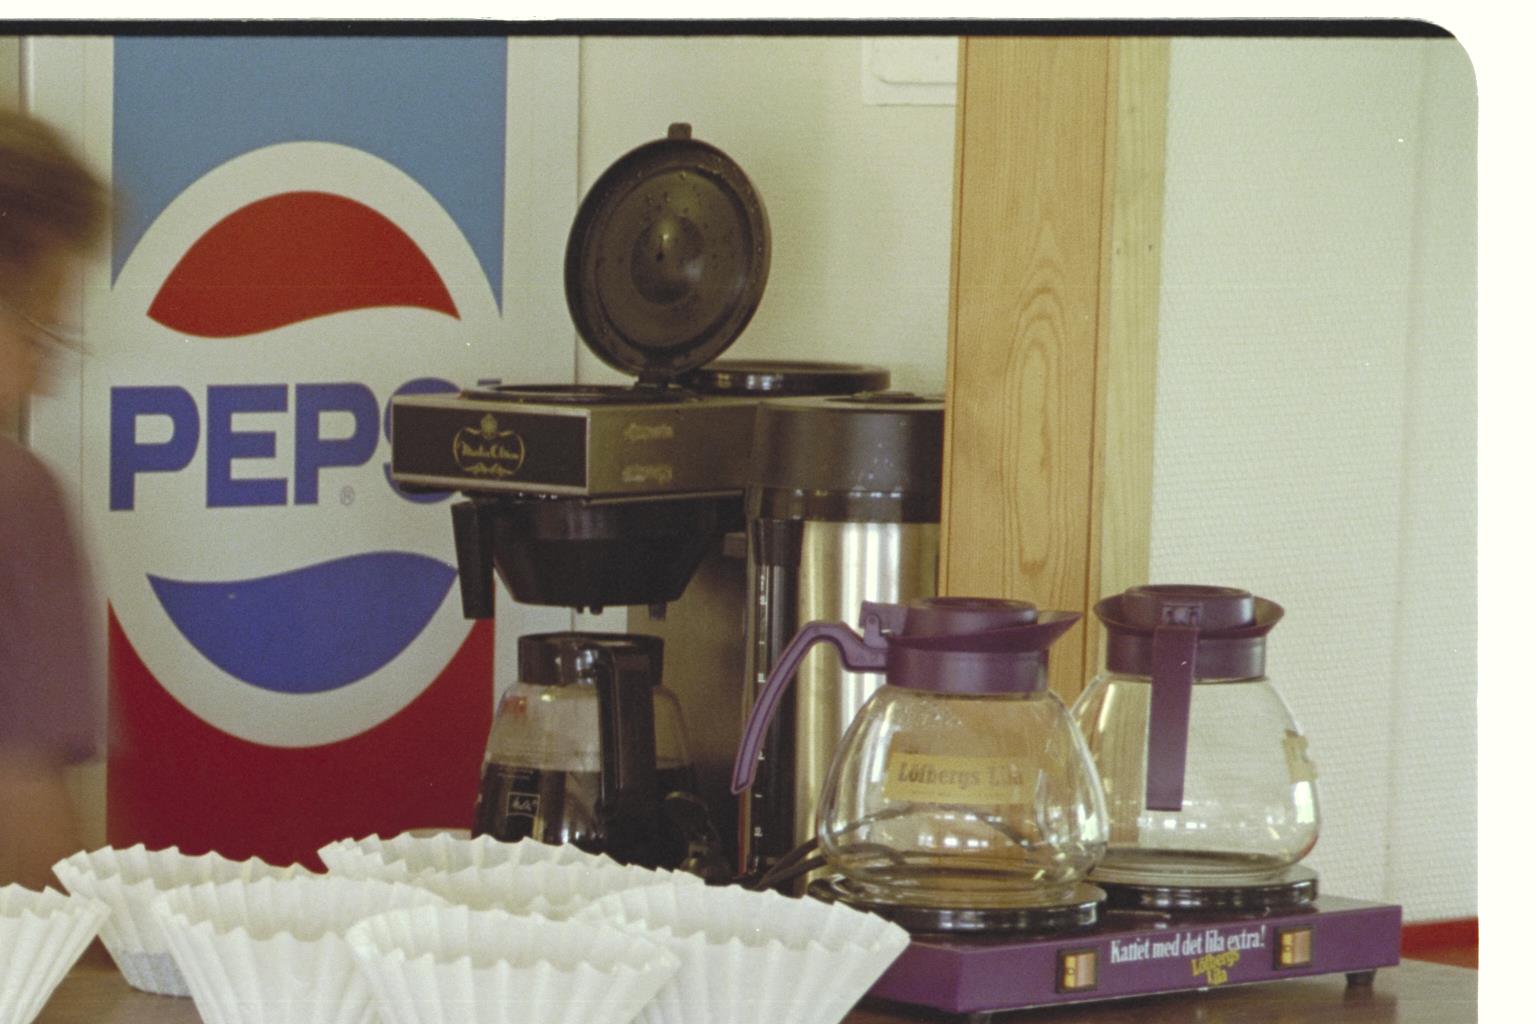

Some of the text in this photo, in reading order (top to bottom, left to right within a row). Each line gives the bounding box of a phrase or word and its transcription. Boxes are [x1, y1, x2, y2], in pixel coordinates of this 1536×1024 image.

[109, 377, 501, 511] PEP
[1152, 933, 1180, 957] med
[1182, 933, 1203, 956] det
[1227, 924, 1266, 950] extra!
